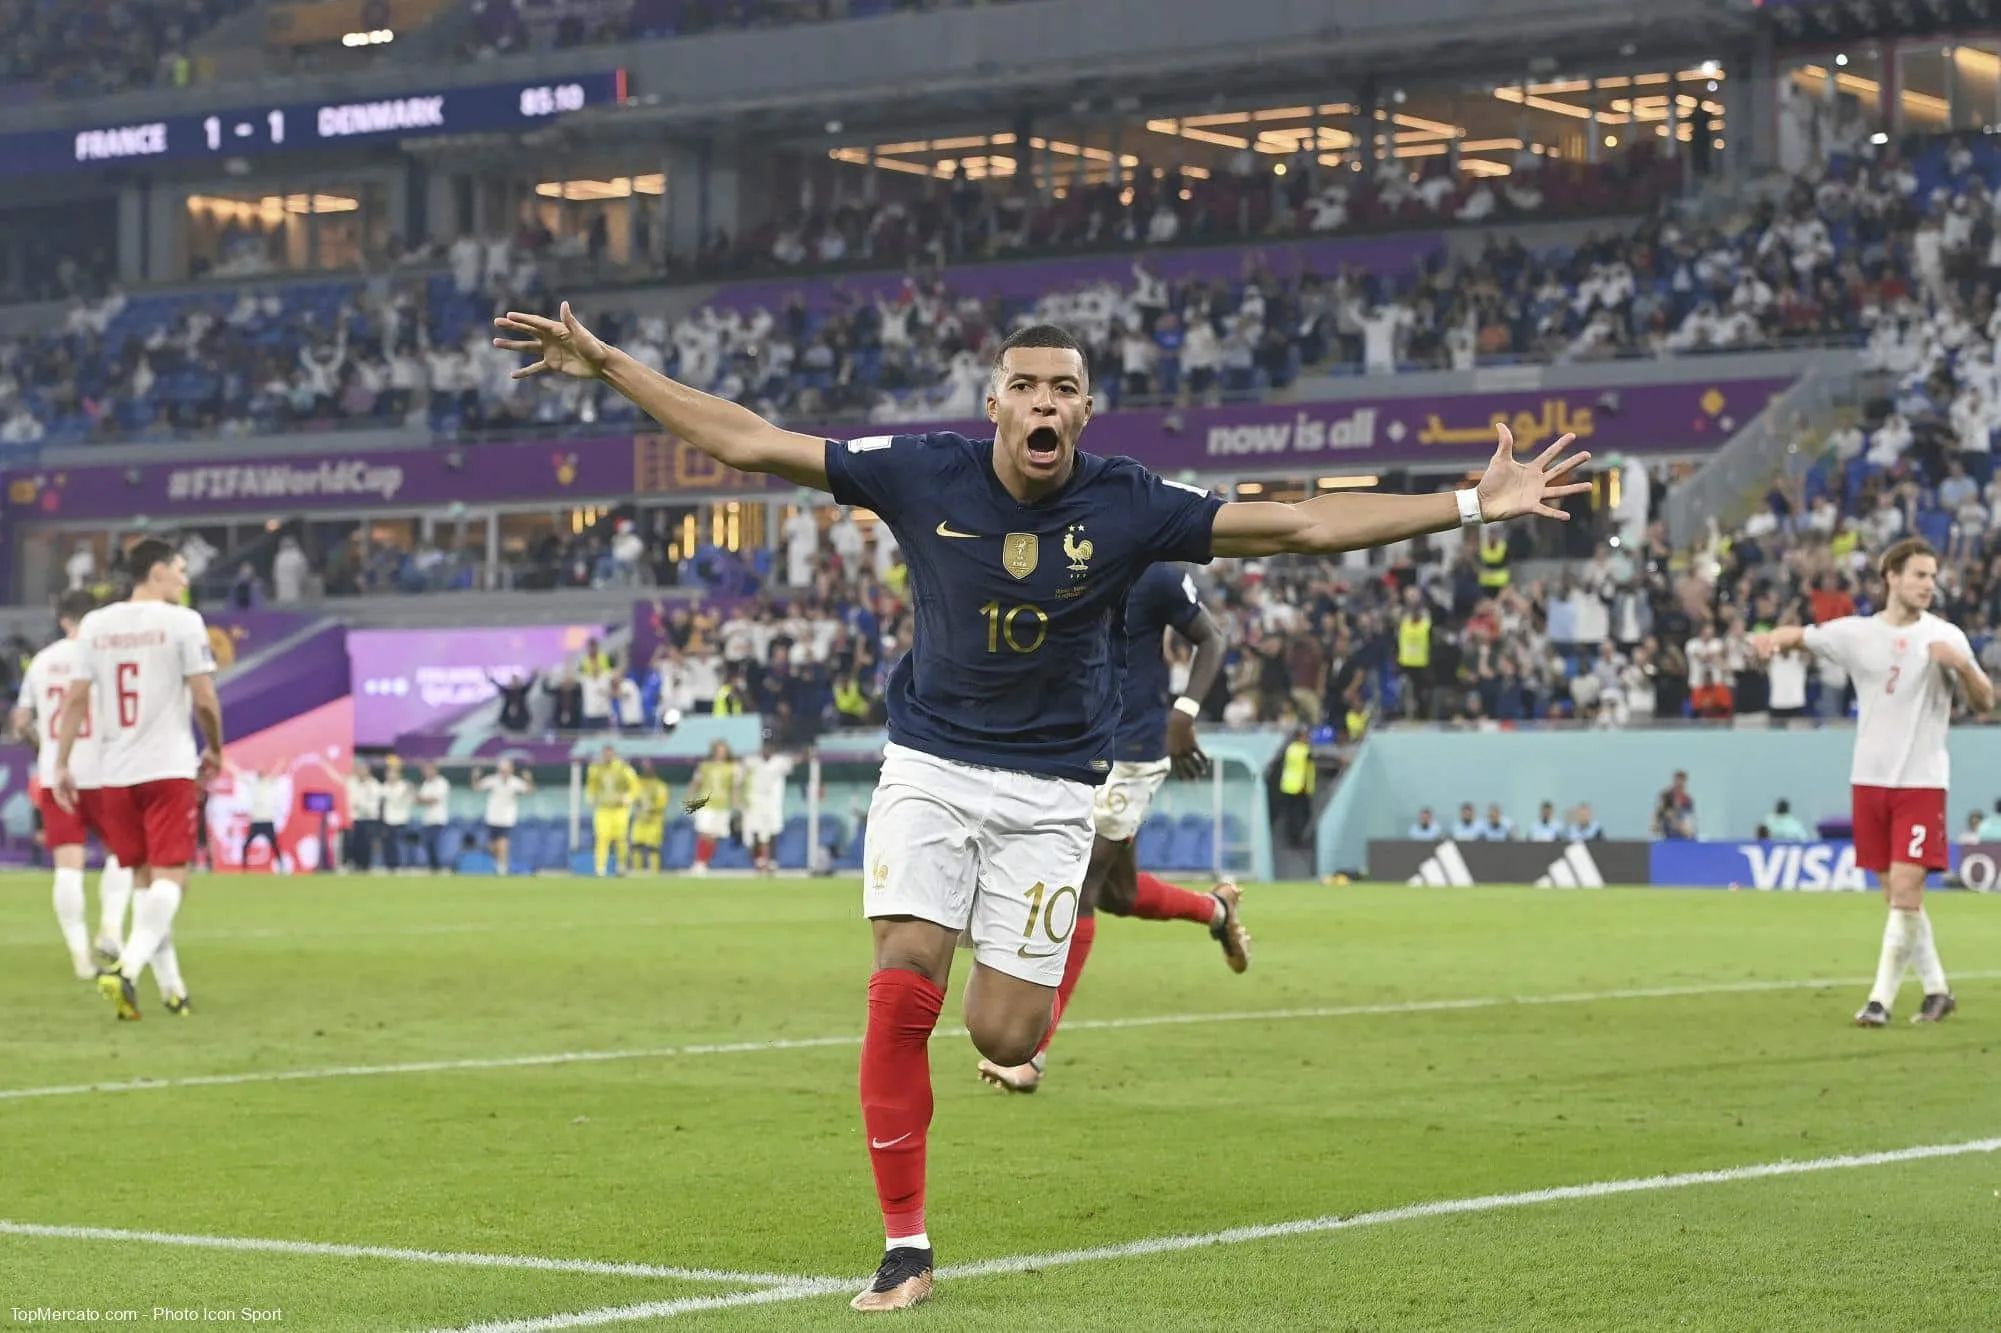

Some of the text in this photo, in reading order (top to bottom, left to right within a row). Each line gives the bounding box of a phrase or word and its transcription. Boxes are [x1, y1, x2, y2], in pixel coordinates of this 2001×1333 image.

[75, 123, 167, 161] FRANCE
[204, 115, 221, 150] 1
[268, 109, 284, 144] 1
[318, 95, 444, 137] DENMARK
[1207, 407, 1377, 456] now is all
[168, 460, 404, 501] #FIFAWorldCup
[980, 602, 1049, 653] 10
[115, 660, 141, 729] 6
[1884, 666, 1901, 694] 2
[1907, 825, 1927, 859] 2
[1738, 845, 1867, 891] VISA
[1023, 881, 1079, 944] 10
